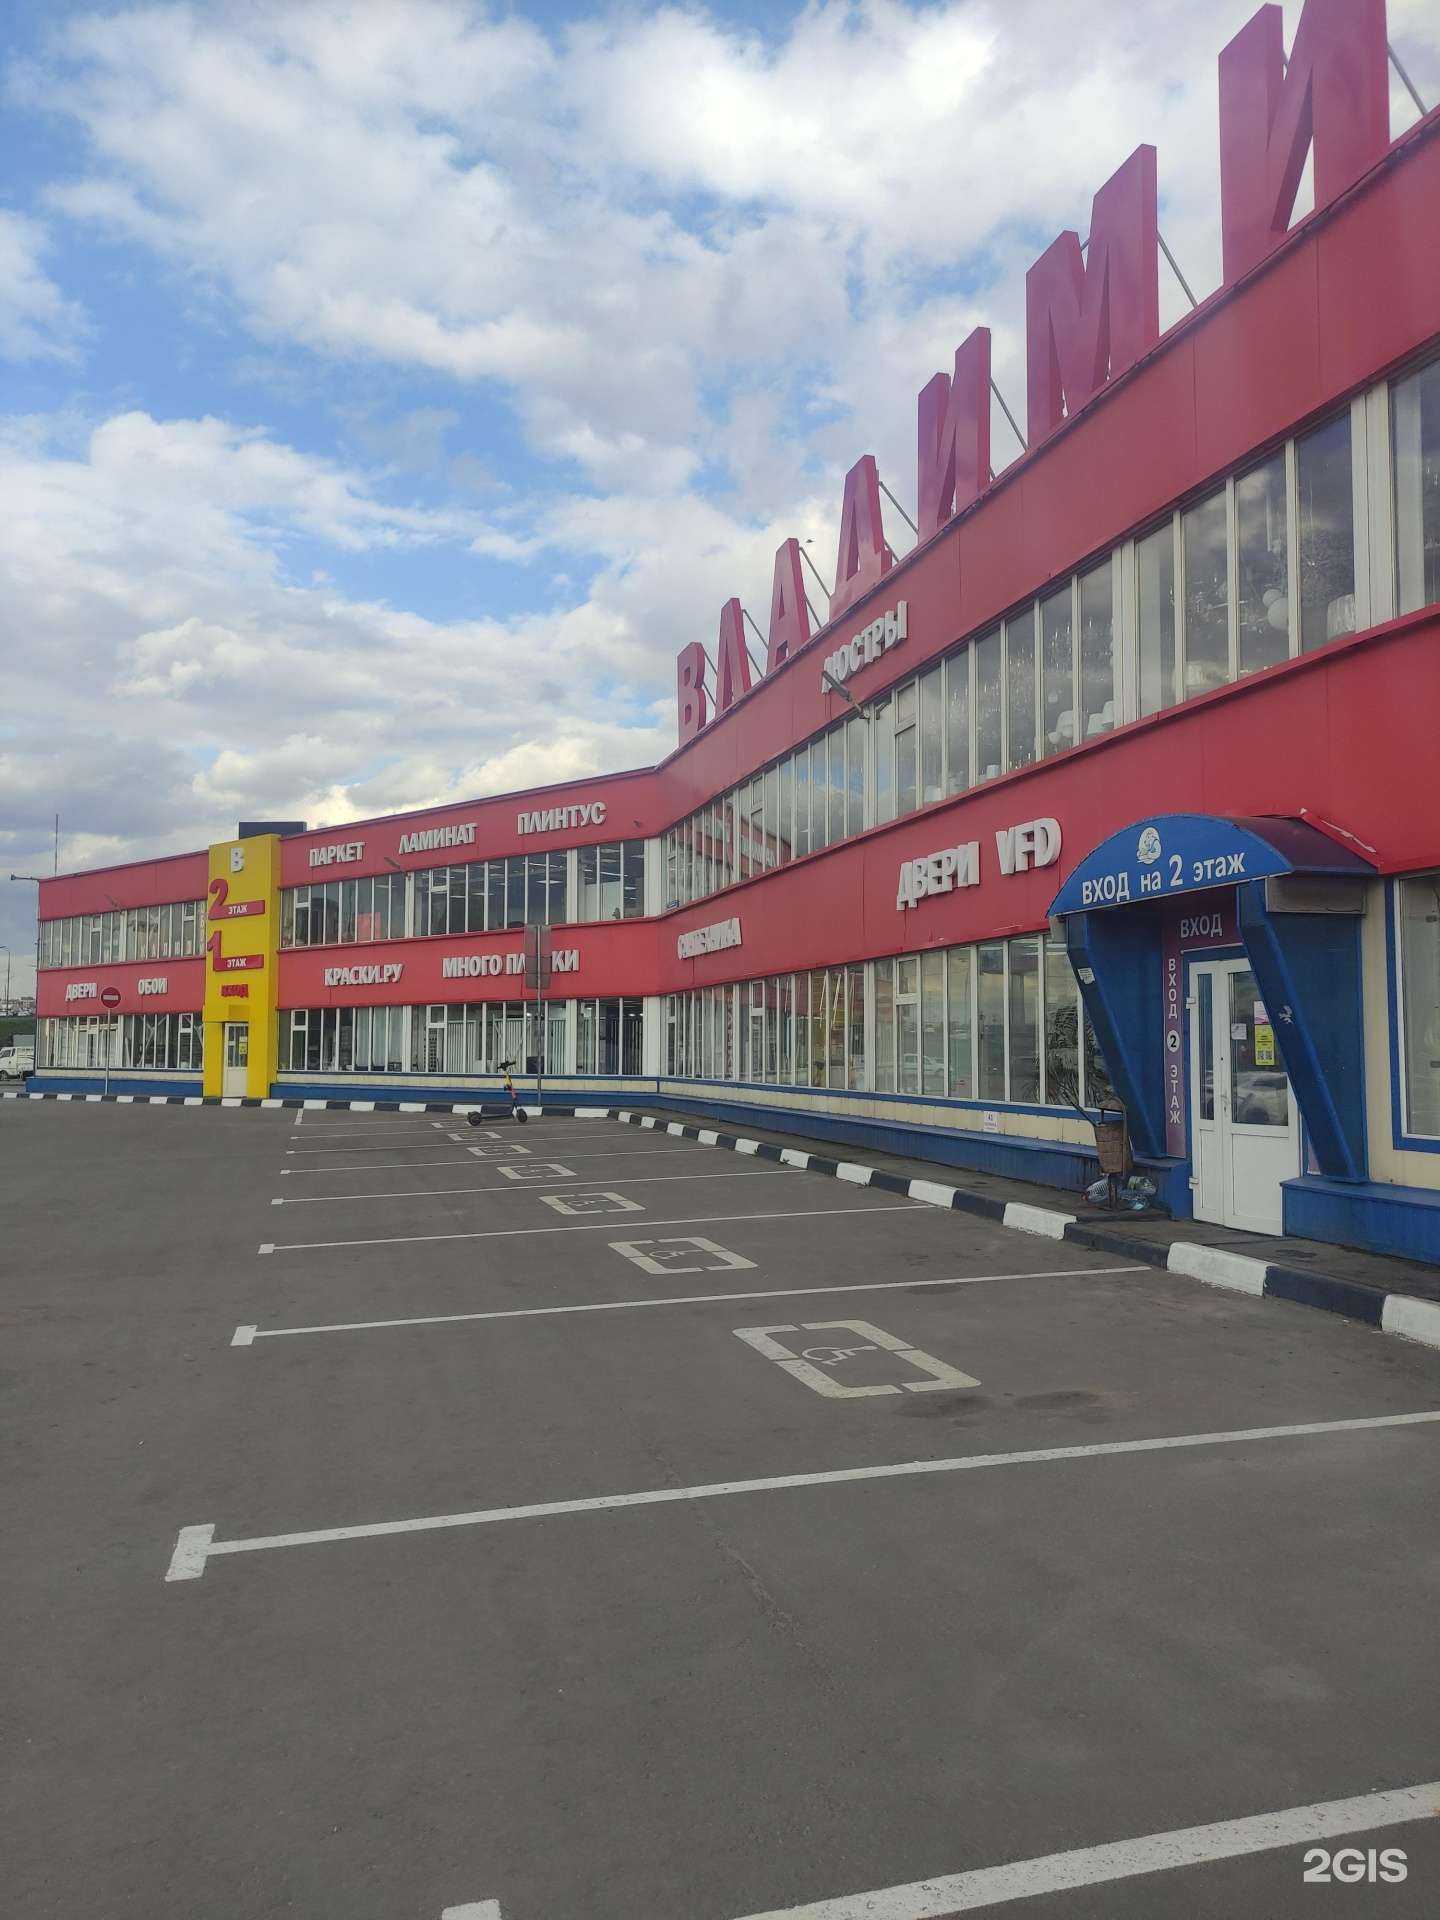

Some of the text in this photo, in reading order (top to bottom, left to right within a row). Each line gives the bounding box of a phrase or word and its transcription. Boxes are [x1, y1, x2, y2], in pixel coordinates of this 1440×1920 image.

[309, 802, 607, 867] ПАРКЕТ ЛАМИНАТ ПЛИНТУС
[995, 817, 1063, 875] VFD
[231, 847, 244, 872] В
[896, 841, 980, 911] ДВЕРИ
[1082, 852, 1246, 905] ВХОД на 2 этаж
[208, 878, 248, 920] 2 ЭТАЖ
[1180, 912, 1223, 938] ВХОД
[207, 930, 222, 971] 1
[226, 957, 247, 969] ЭТАЖ
[442, 949, 580, 978] МНОГО ПЛКИ
[65, 982, 98, 1001] ДВЕРИ
[138, 977, 168, 995] ОБОИ
[325, 963, 403, 987] КРАСКИ.РУ
[1168, 958, 1181, 1124] ВХОД 2 ЭТАЖ
